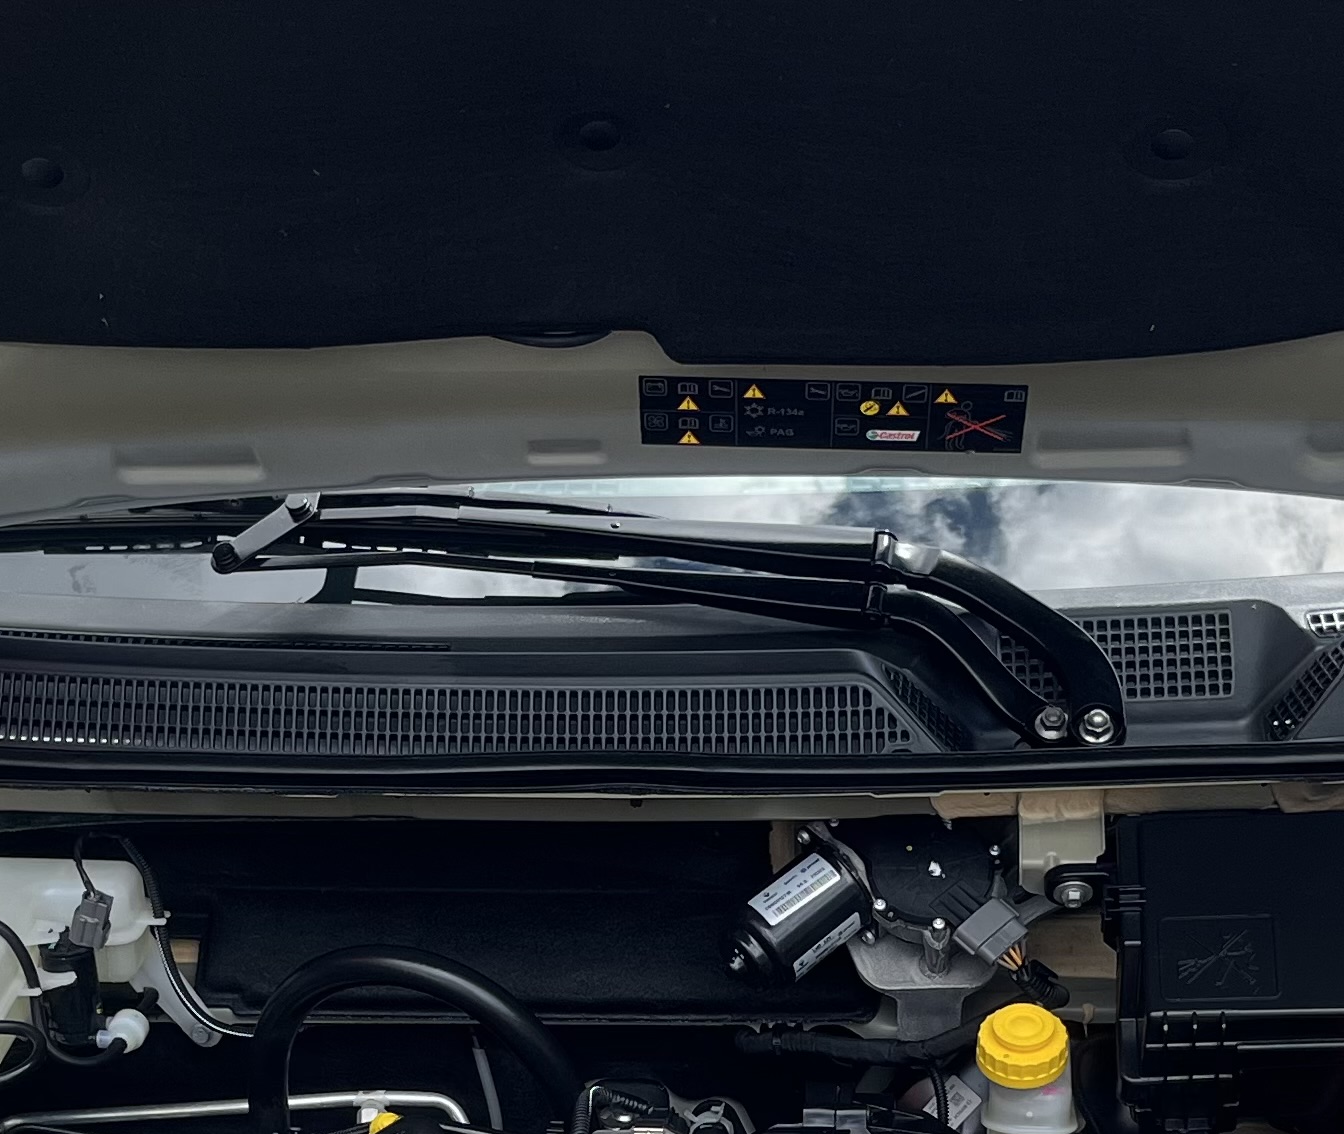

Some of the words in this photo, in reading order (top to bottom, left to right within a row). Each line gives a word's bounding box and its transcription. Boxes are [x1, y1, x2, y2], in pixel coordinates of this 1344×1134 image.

[767, 407, 805, 417] R-134a
[769, 428, 795, 437] PAG
[879, 431, 916, 441] Castrol
